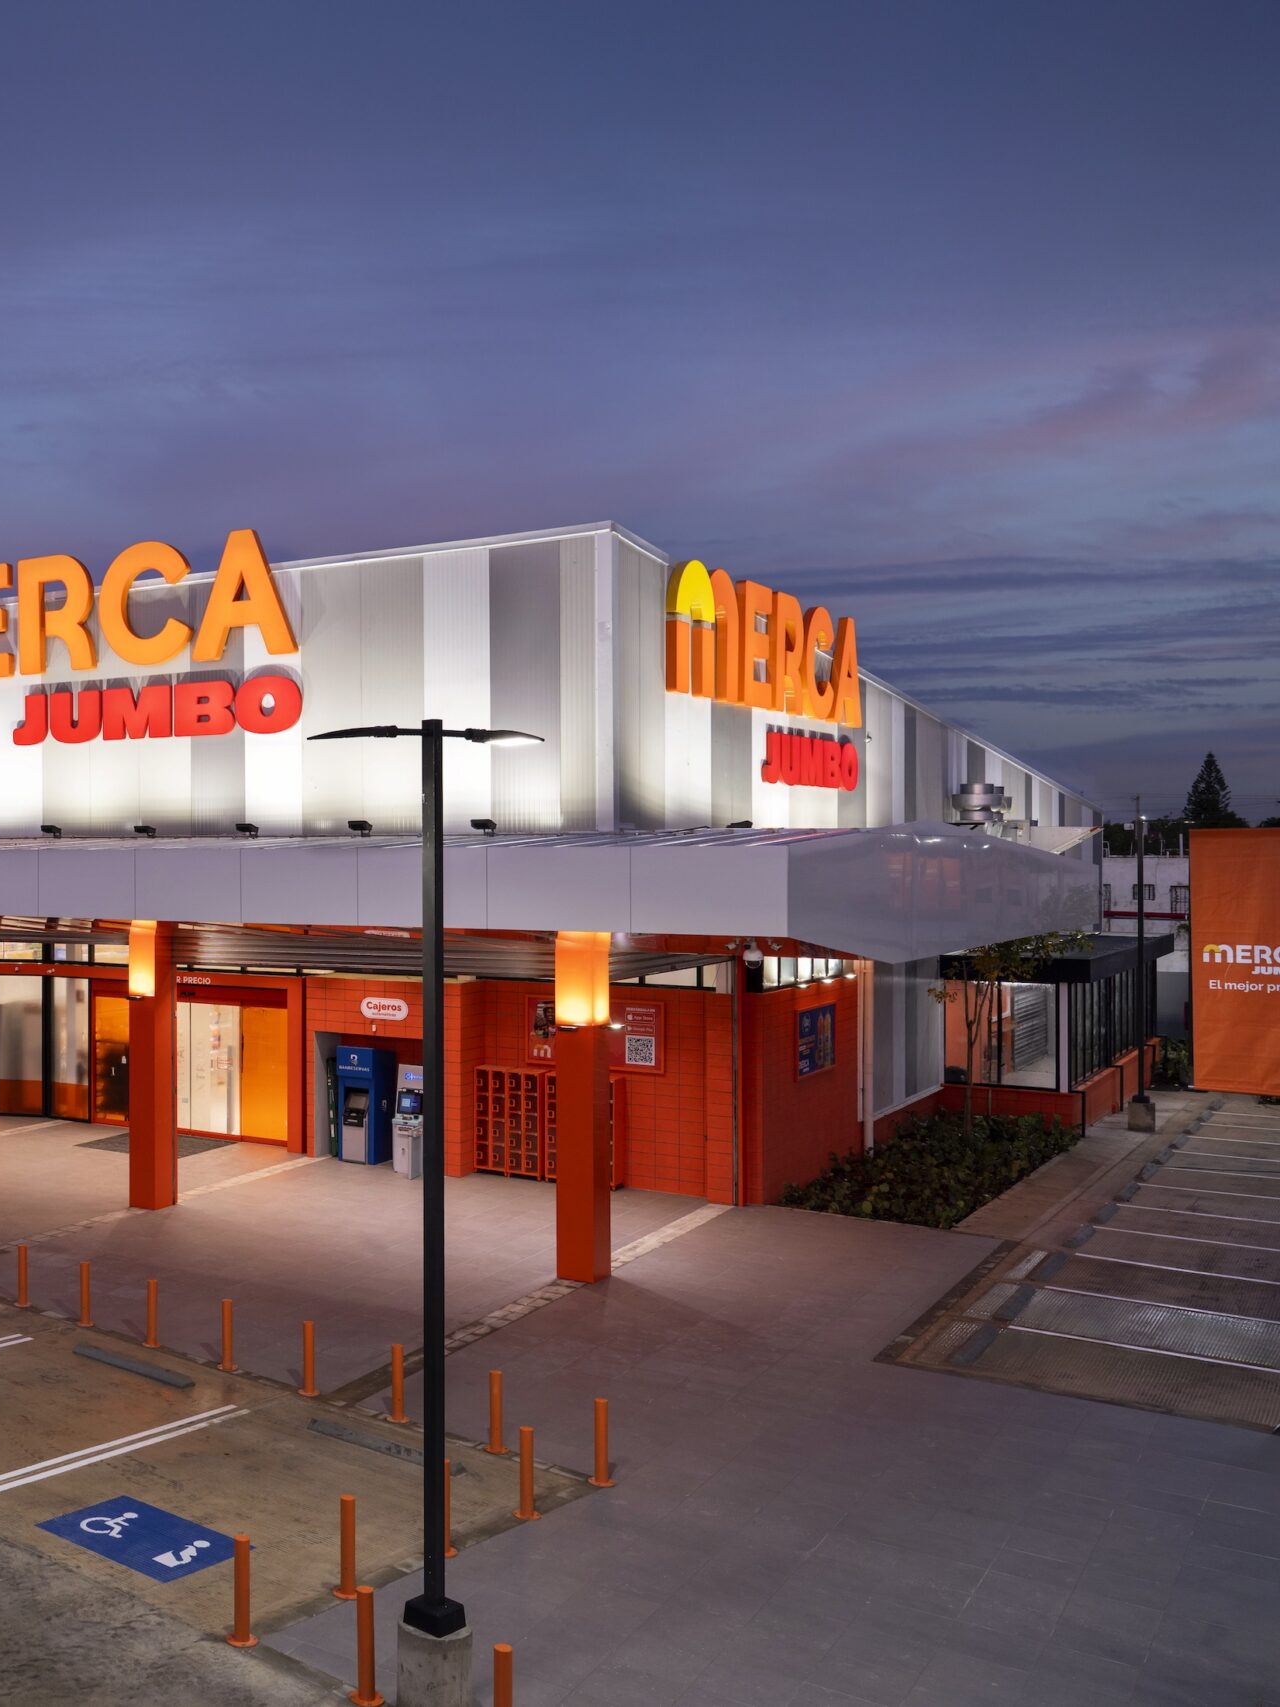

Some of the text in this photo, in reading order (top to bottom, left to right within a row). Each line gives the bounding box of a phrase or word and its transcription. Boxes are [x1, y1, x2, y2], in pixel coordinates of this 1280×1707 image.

[13, 675, 303, 745] JUMBO
[761, 732, 858, 791] JUMBO
[183, 977, 211, 985] PRECIO
[1209, 980, 1222, 990] El
[1224, 981, 1263, 993] mejor
[366, 1002, 402, 1012] Cajeros
